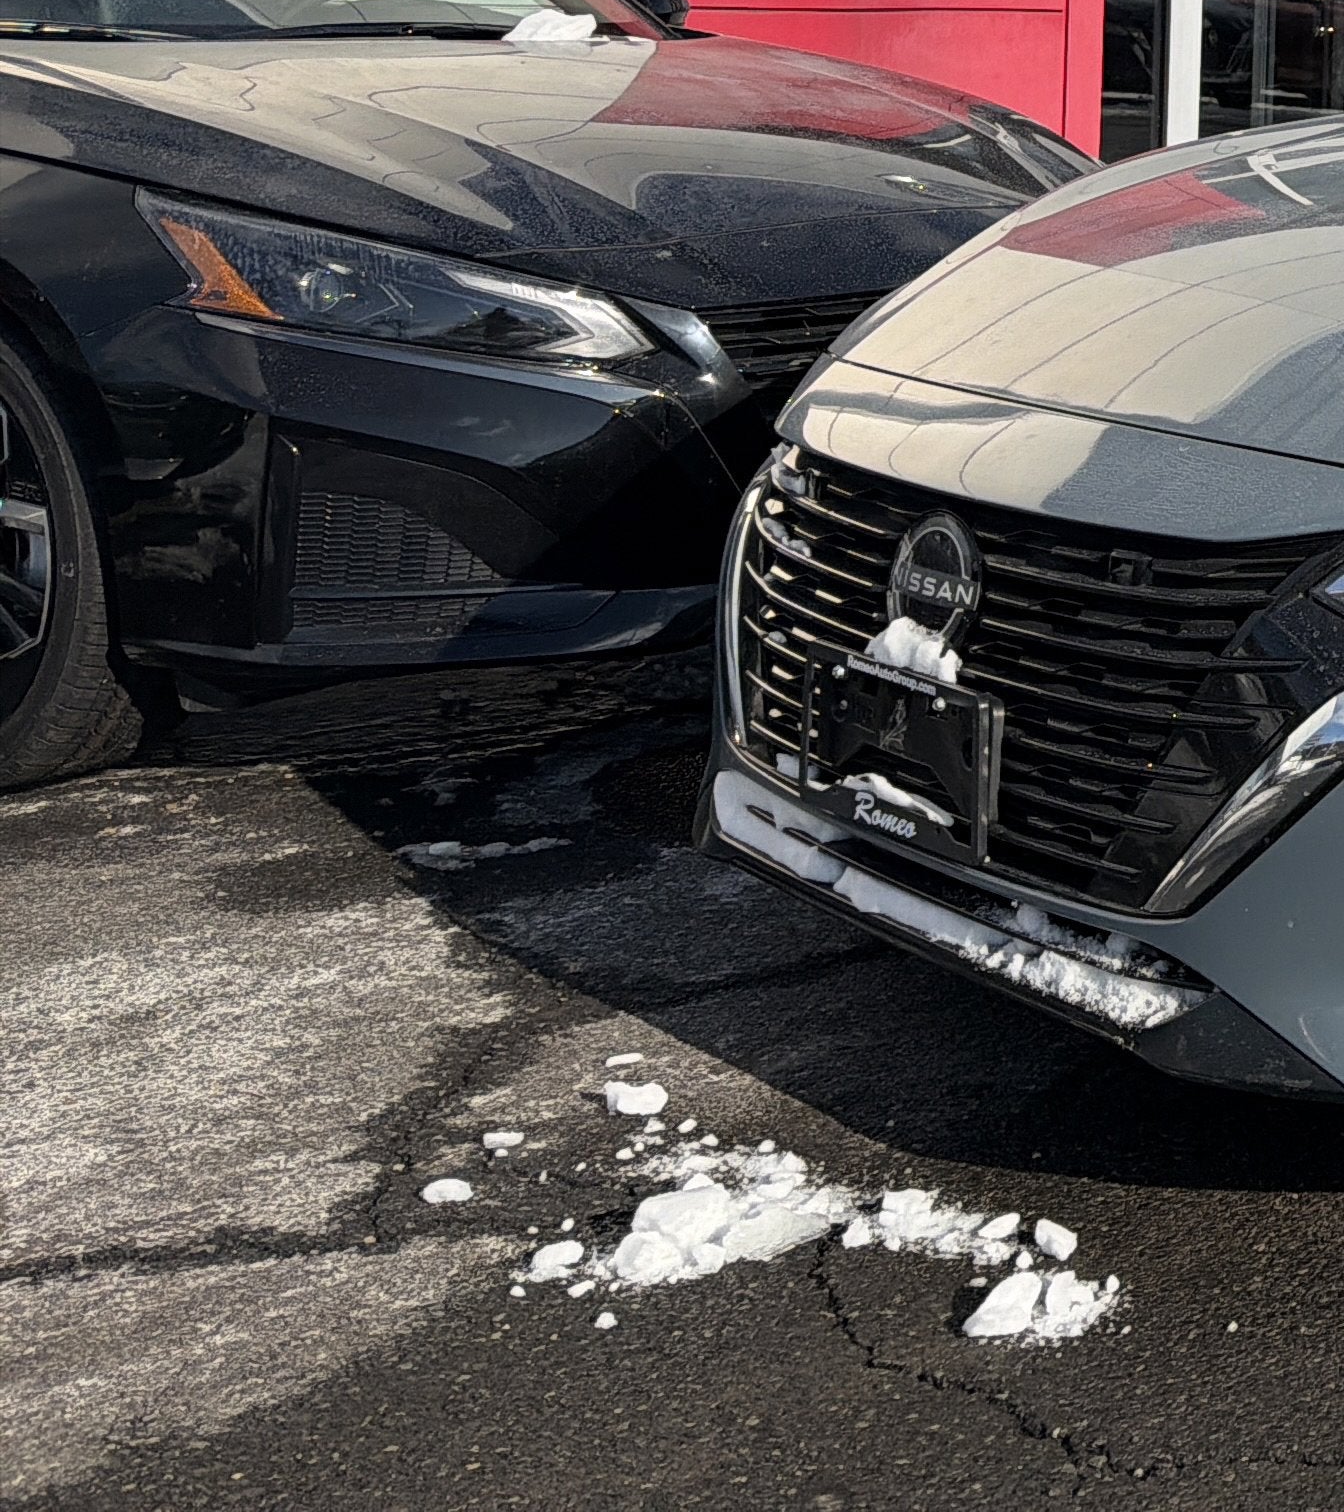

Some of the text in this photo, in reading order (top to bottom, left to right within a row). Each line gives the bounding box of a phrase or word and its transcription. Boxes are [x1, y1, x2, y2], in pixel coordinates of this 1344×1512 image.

[894, 566, 975, 605] NISSAN
[847, 654, 937, 697] RomeoAutoGroup.com
[853, 791, 917, 839] Romeo
